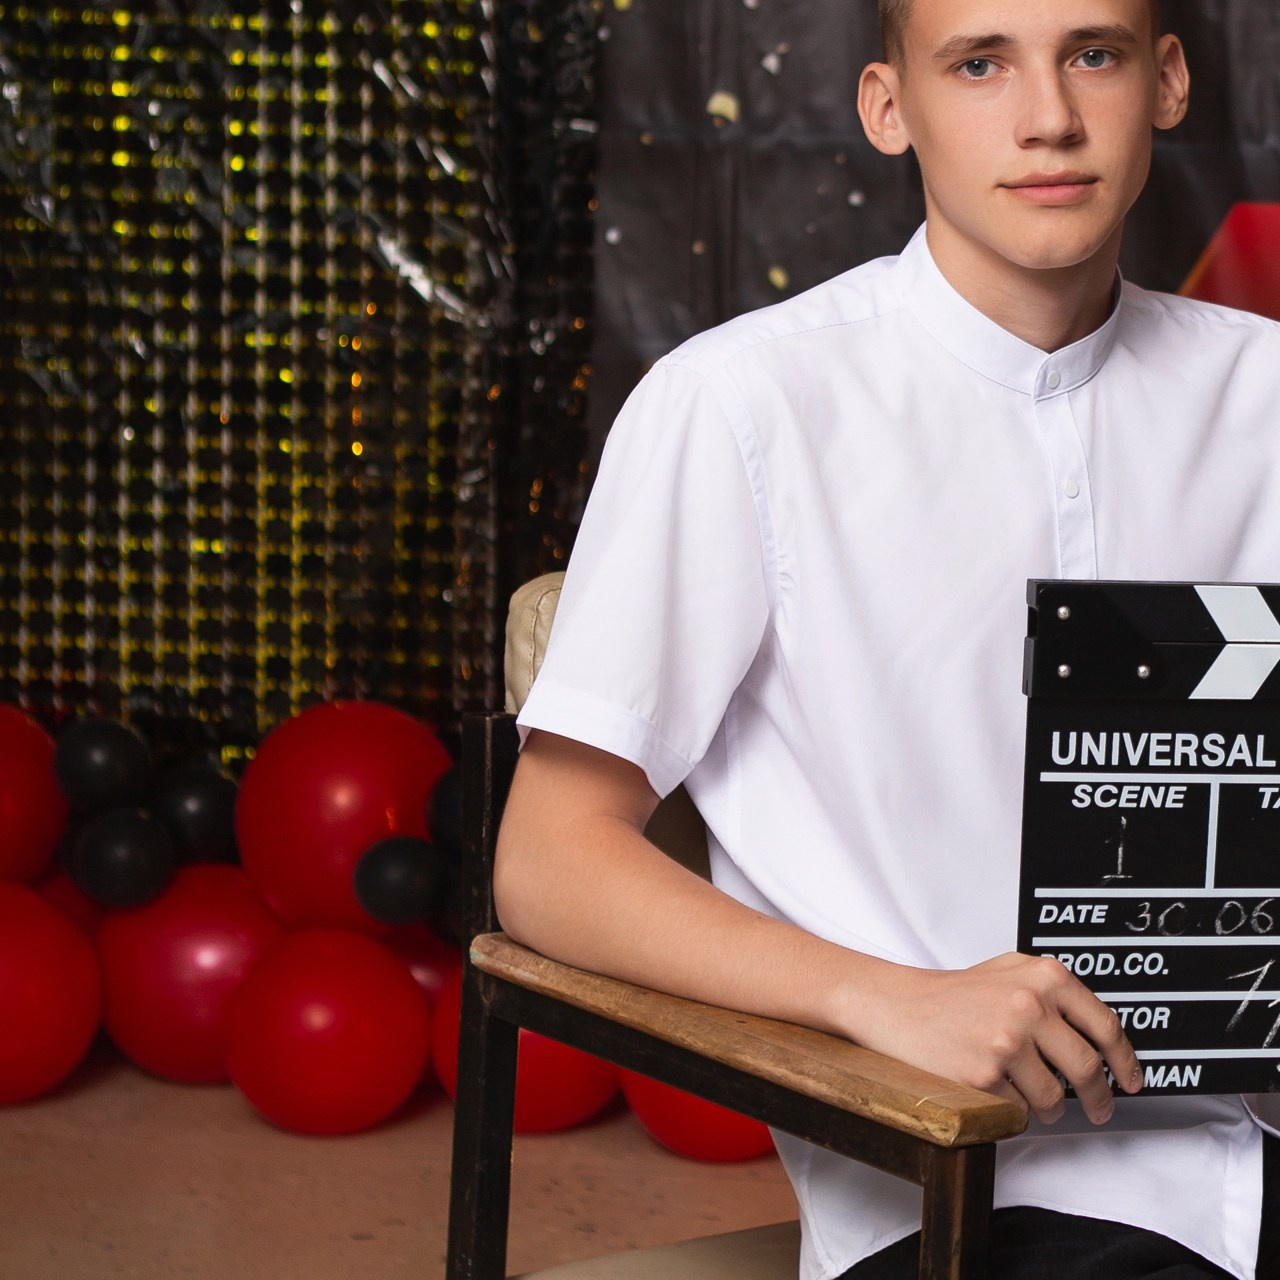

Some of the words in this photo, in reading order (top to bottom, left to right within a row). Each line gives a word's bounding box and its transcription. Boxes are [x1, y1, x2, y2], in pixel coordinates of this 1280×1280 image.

[1051, 731, 1277, 767] UNIVERSAL
[1071, 784, 1188, 809] SCENE
[1038, 904, 1109, 924] DATE
[1040, 952, 1170, 977] ROD.CO.
